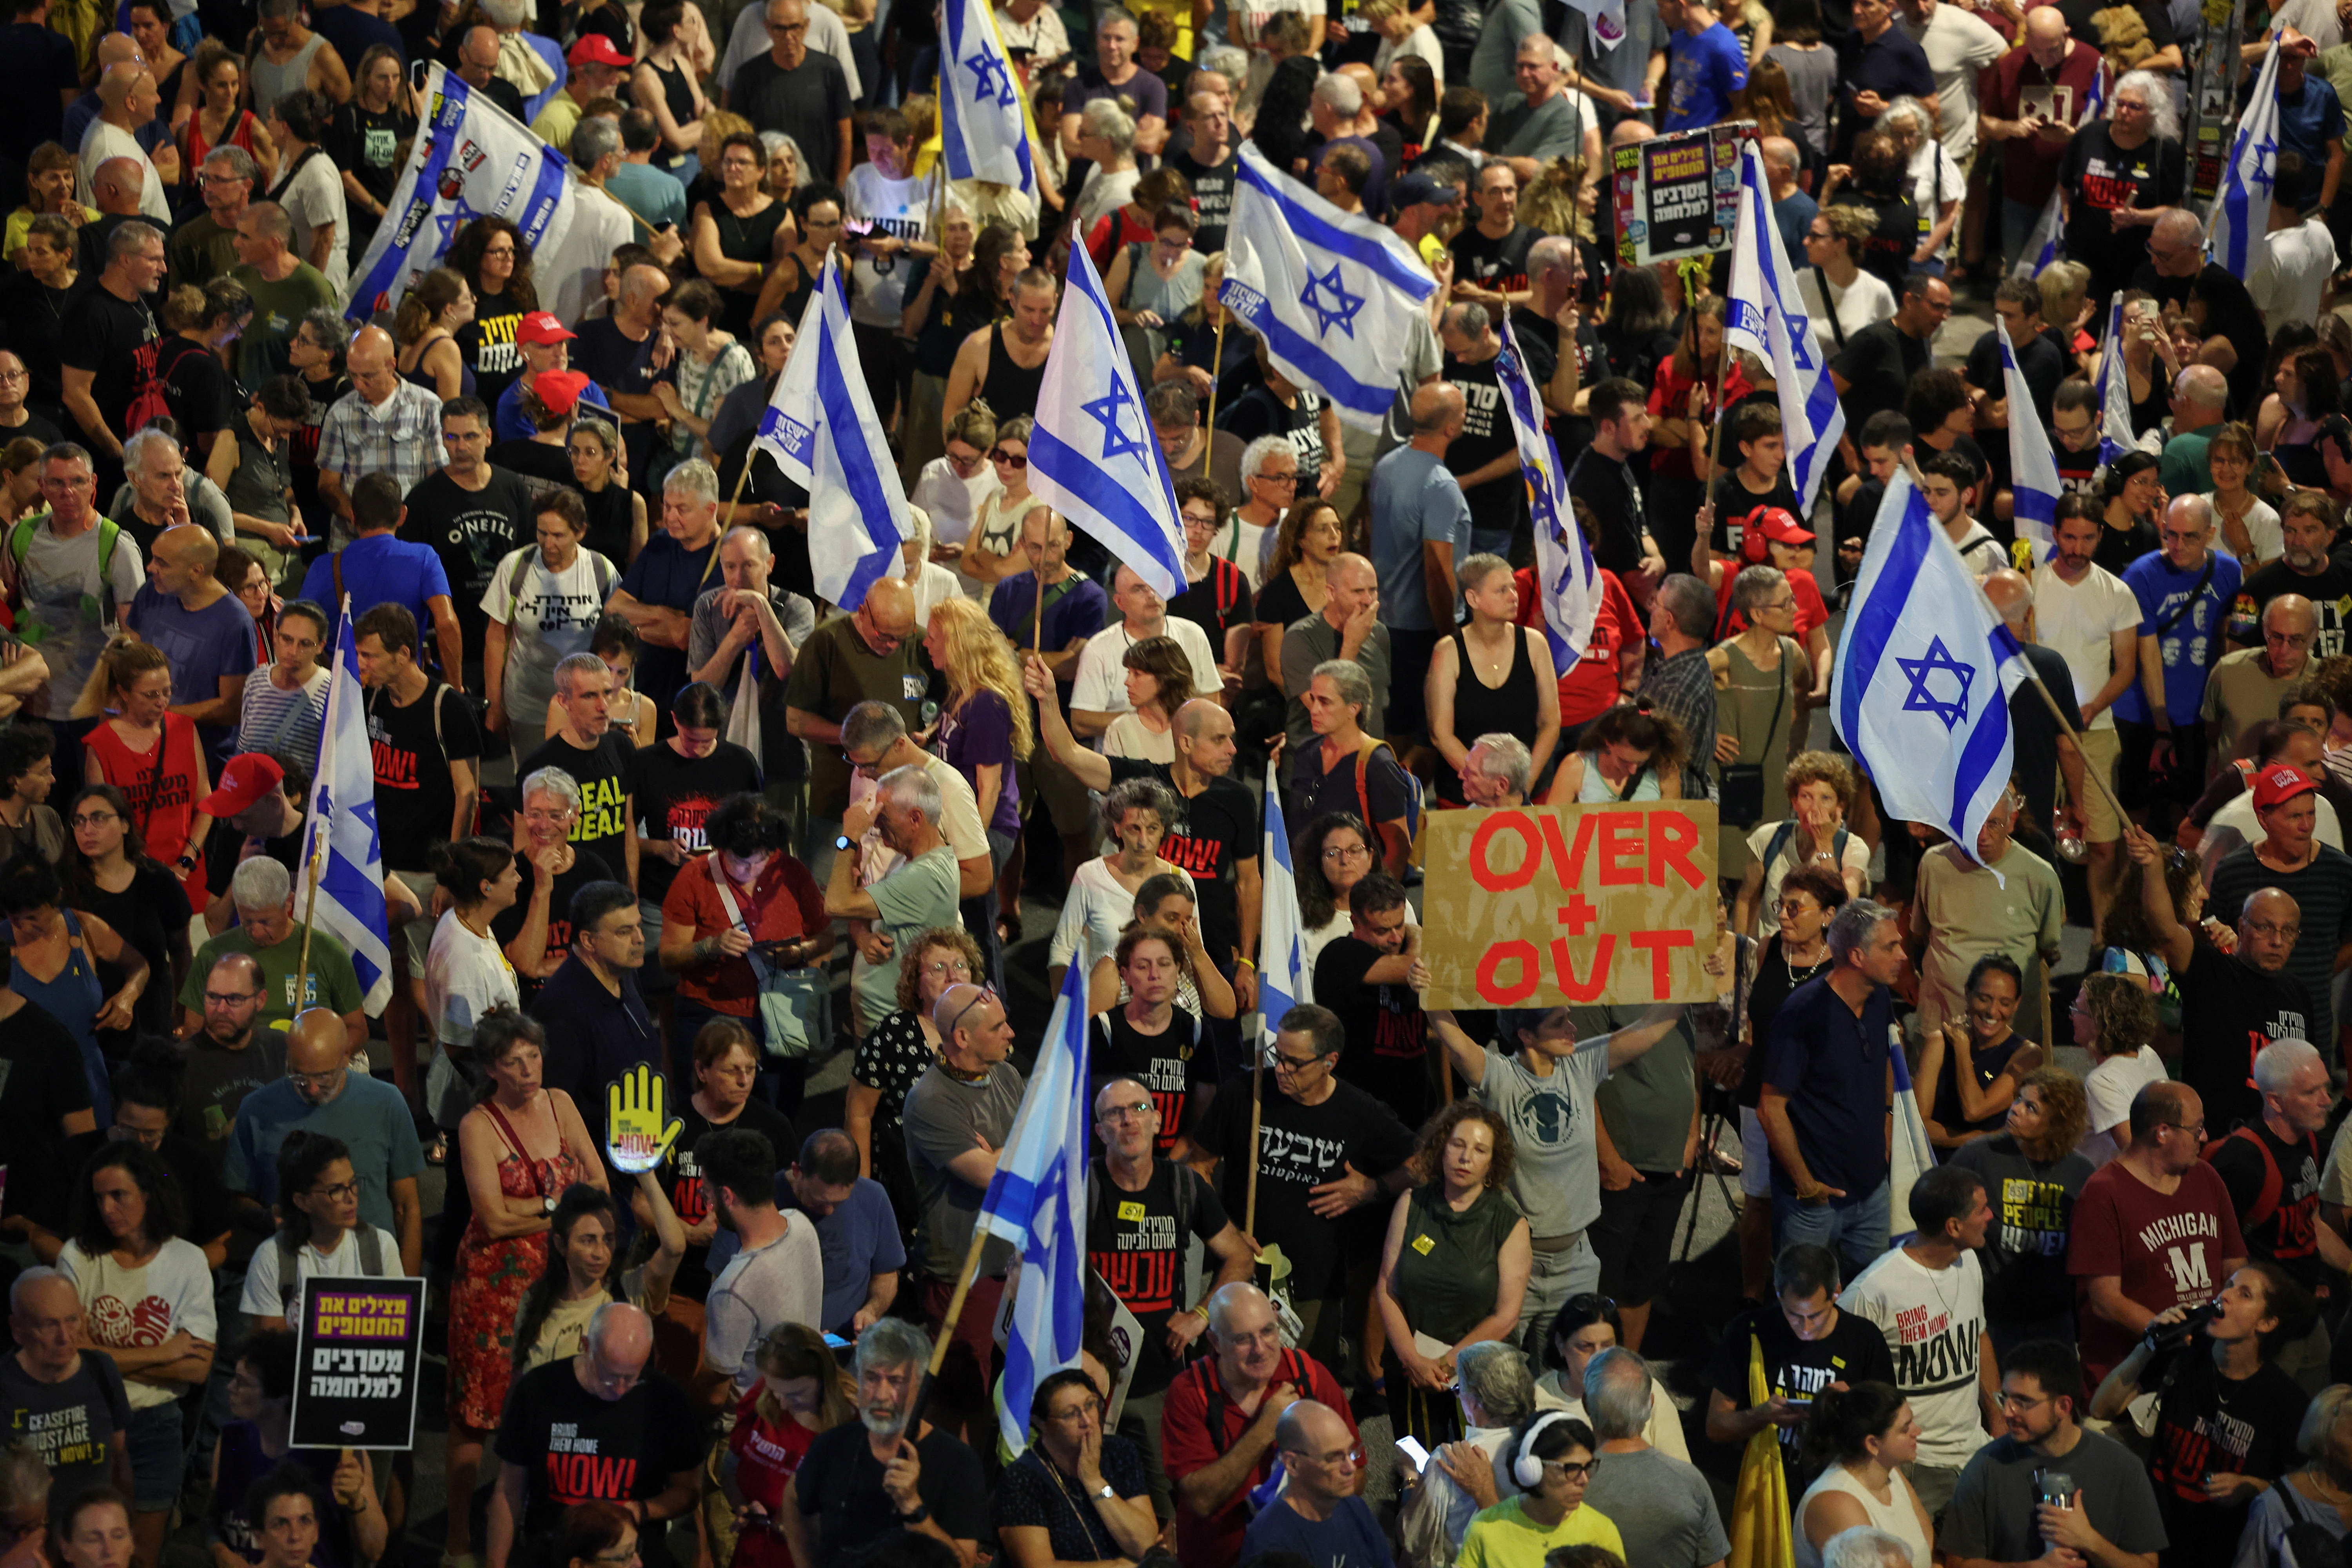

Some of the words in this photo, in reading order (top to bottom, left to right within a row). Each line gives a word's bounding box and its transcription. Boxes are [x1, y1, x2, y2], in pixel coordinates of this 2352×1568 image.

[1653, 161, 1706, 180] החטופים
[1653, 181, 1707, 204] מסרבים
[1654, 201, 1708, 223] למלחמה
[448, 518, 515, 544] O'NEILL
[121, 773, 187, 799] משחות
[132, 789, 189, 813] החטפי
[568, 806, 625, 841] DEAL
[1470, 810, 1706, 892] OVER
[1476, 929, 1694, 1006] OUT
[1151, 1057, 1185, 1073] מחזירים
[1139, 1073, 1160, 1090] הבית
[1162, 1075, 1186, 1092] אותם
[674, 1178, 708, 1216] NO
[1139, 1216, 1176, 1234] מחזירים
[2003, 1204, 2064, 1230] PEOPLE
[1118, 1232, 1150, 1250] הביתה
[1152, 1232, 1176, 1250] אותם
[2139, 1212, 2218, 1252] MICHIGAN
[1089, 1250, 1176, 1299] עכשי
[2167, 1241, 2213, 1292] M
[319, 1296, 344, 1314] את
[349, 1296, 407, 1315] מצילים
[317, 1316, 407, 1336] החטופים
[1896, 1305, 1927, 1329] BRING
[1900, 1325, 1927, 1345] THEM
[312, 1347, 405, 1373] מסרבים
[1898, 1318, 1978, 1386] NOW!
[310, 1375, 401, 1398] למלחמה
[29, 1405, 87, 1432] CEASEFIRE
[551, 1423, 579, 1438] BRING
[43, 1450, 58, 1466] AL
[60, 1443, 93, 1464] NOW!
[549, 1437, 572, 1452] THEM
[572, 1438, 599, 1454] HOME
[546, 1453, 637, 1499] NOW!
